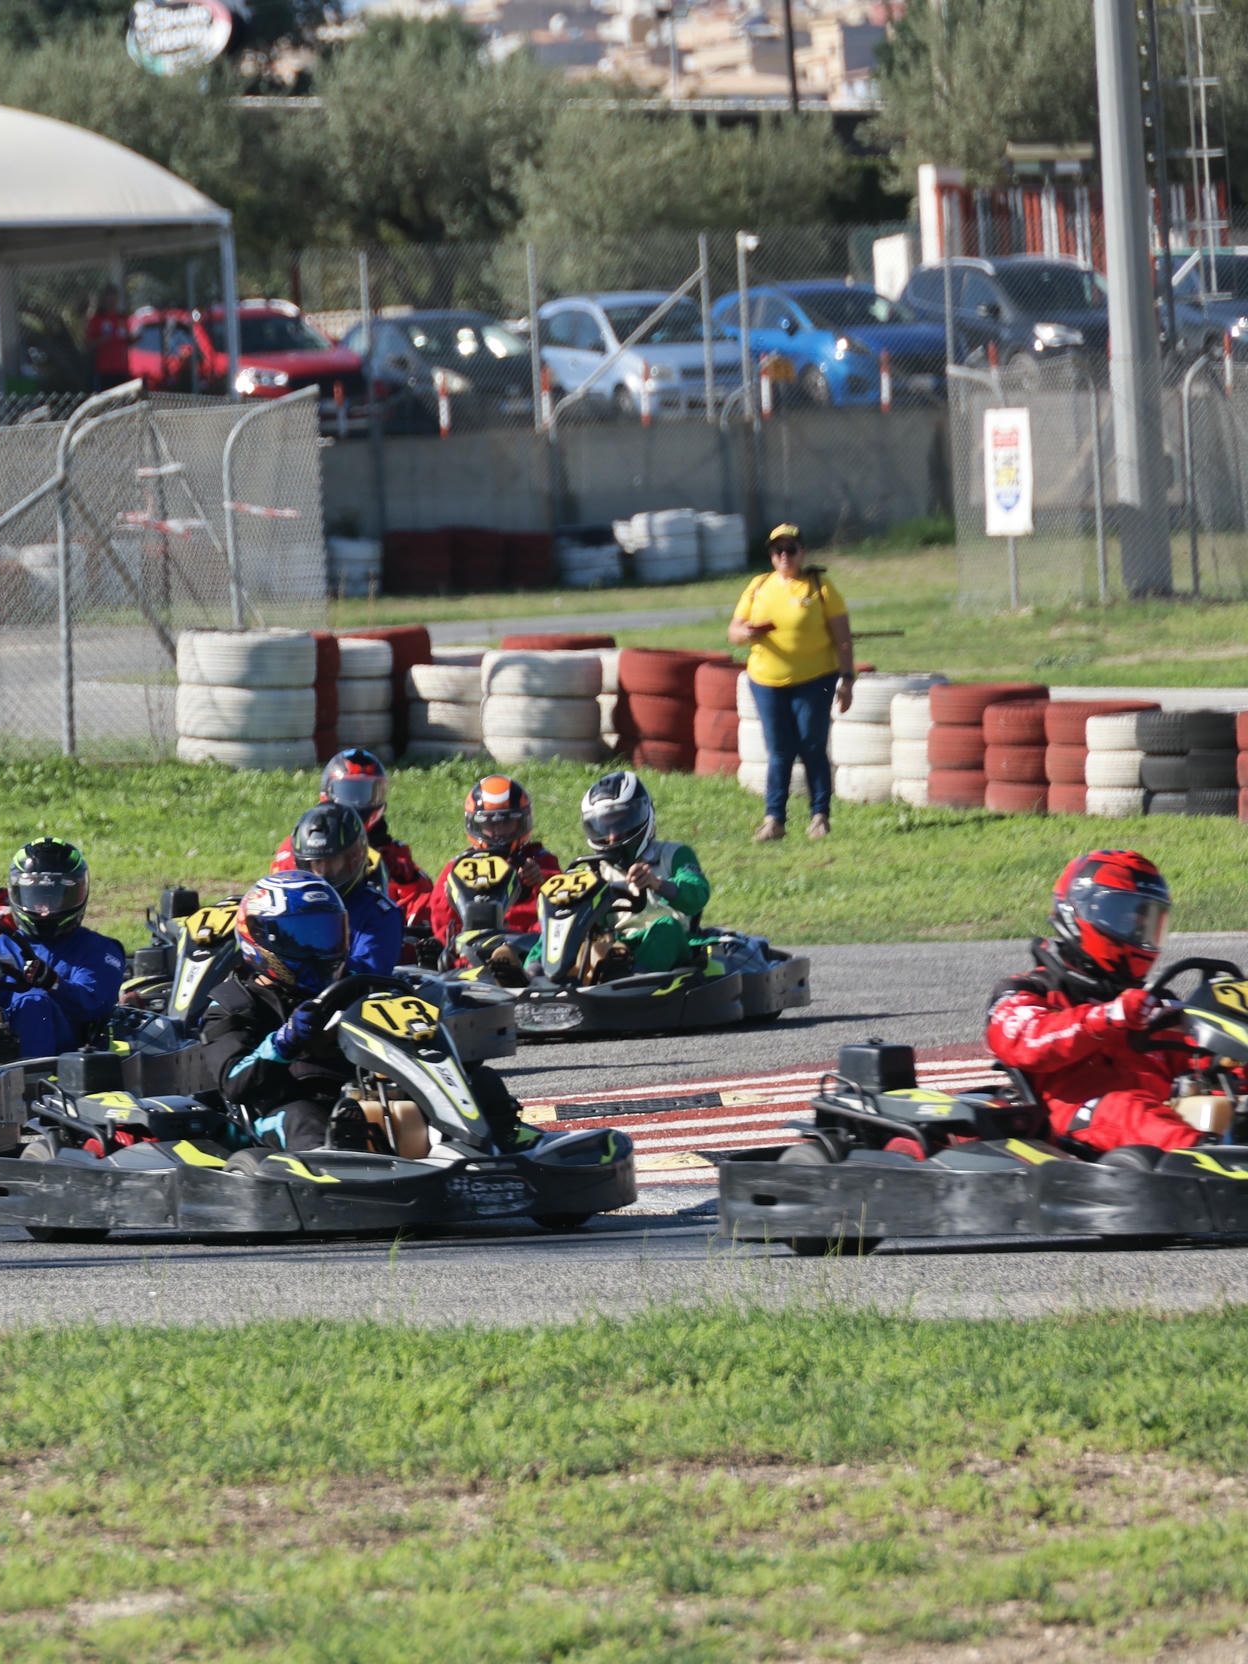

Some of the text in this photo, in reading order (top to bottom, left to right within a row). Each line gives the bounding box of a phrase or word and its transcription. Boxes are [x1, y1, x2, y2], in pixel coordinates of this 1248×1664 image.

[462, 859, 496, 881] 31
[548, 872, 588, 897] 25
[198, 910, 238, 934] 17
[370, 1000, 436, 1031] 13
